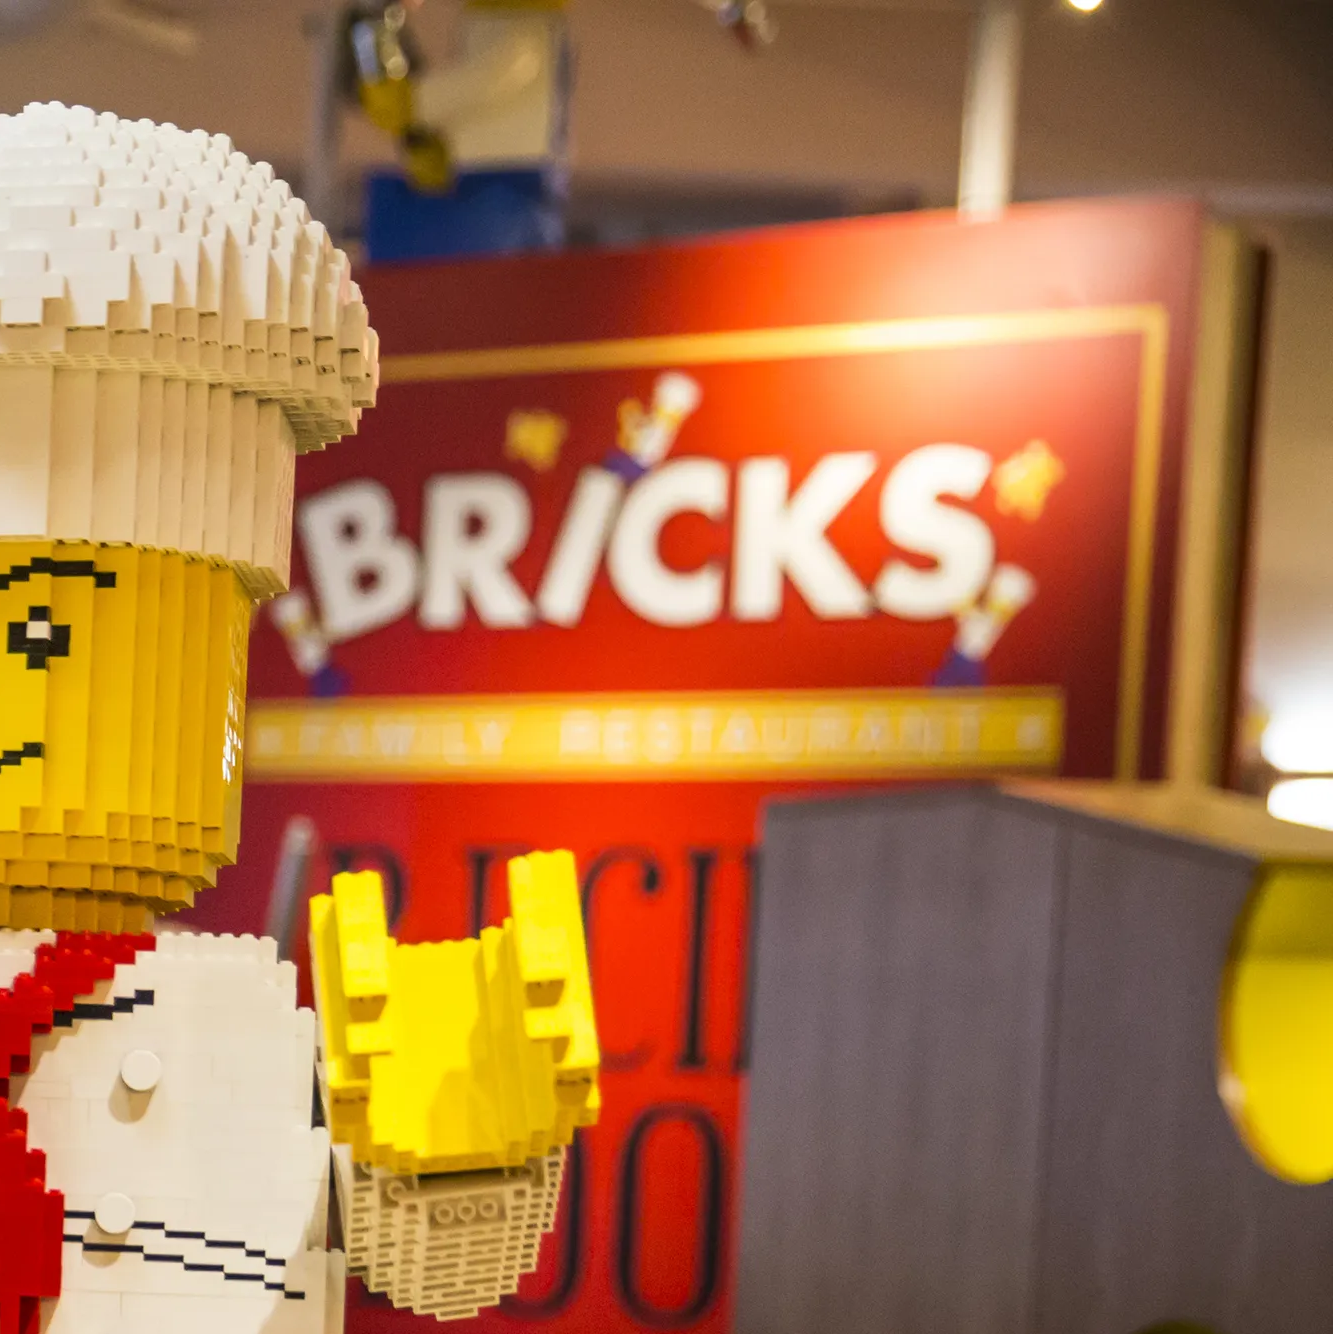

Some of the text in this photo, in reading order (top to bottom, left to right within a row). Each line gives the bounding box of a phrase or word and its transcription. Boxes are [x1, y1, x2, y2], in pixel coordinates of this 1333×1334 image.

[299, 442, 997, 643] BRICKS
[299, 704, 981, 765] FAMILY RESTAURANT
